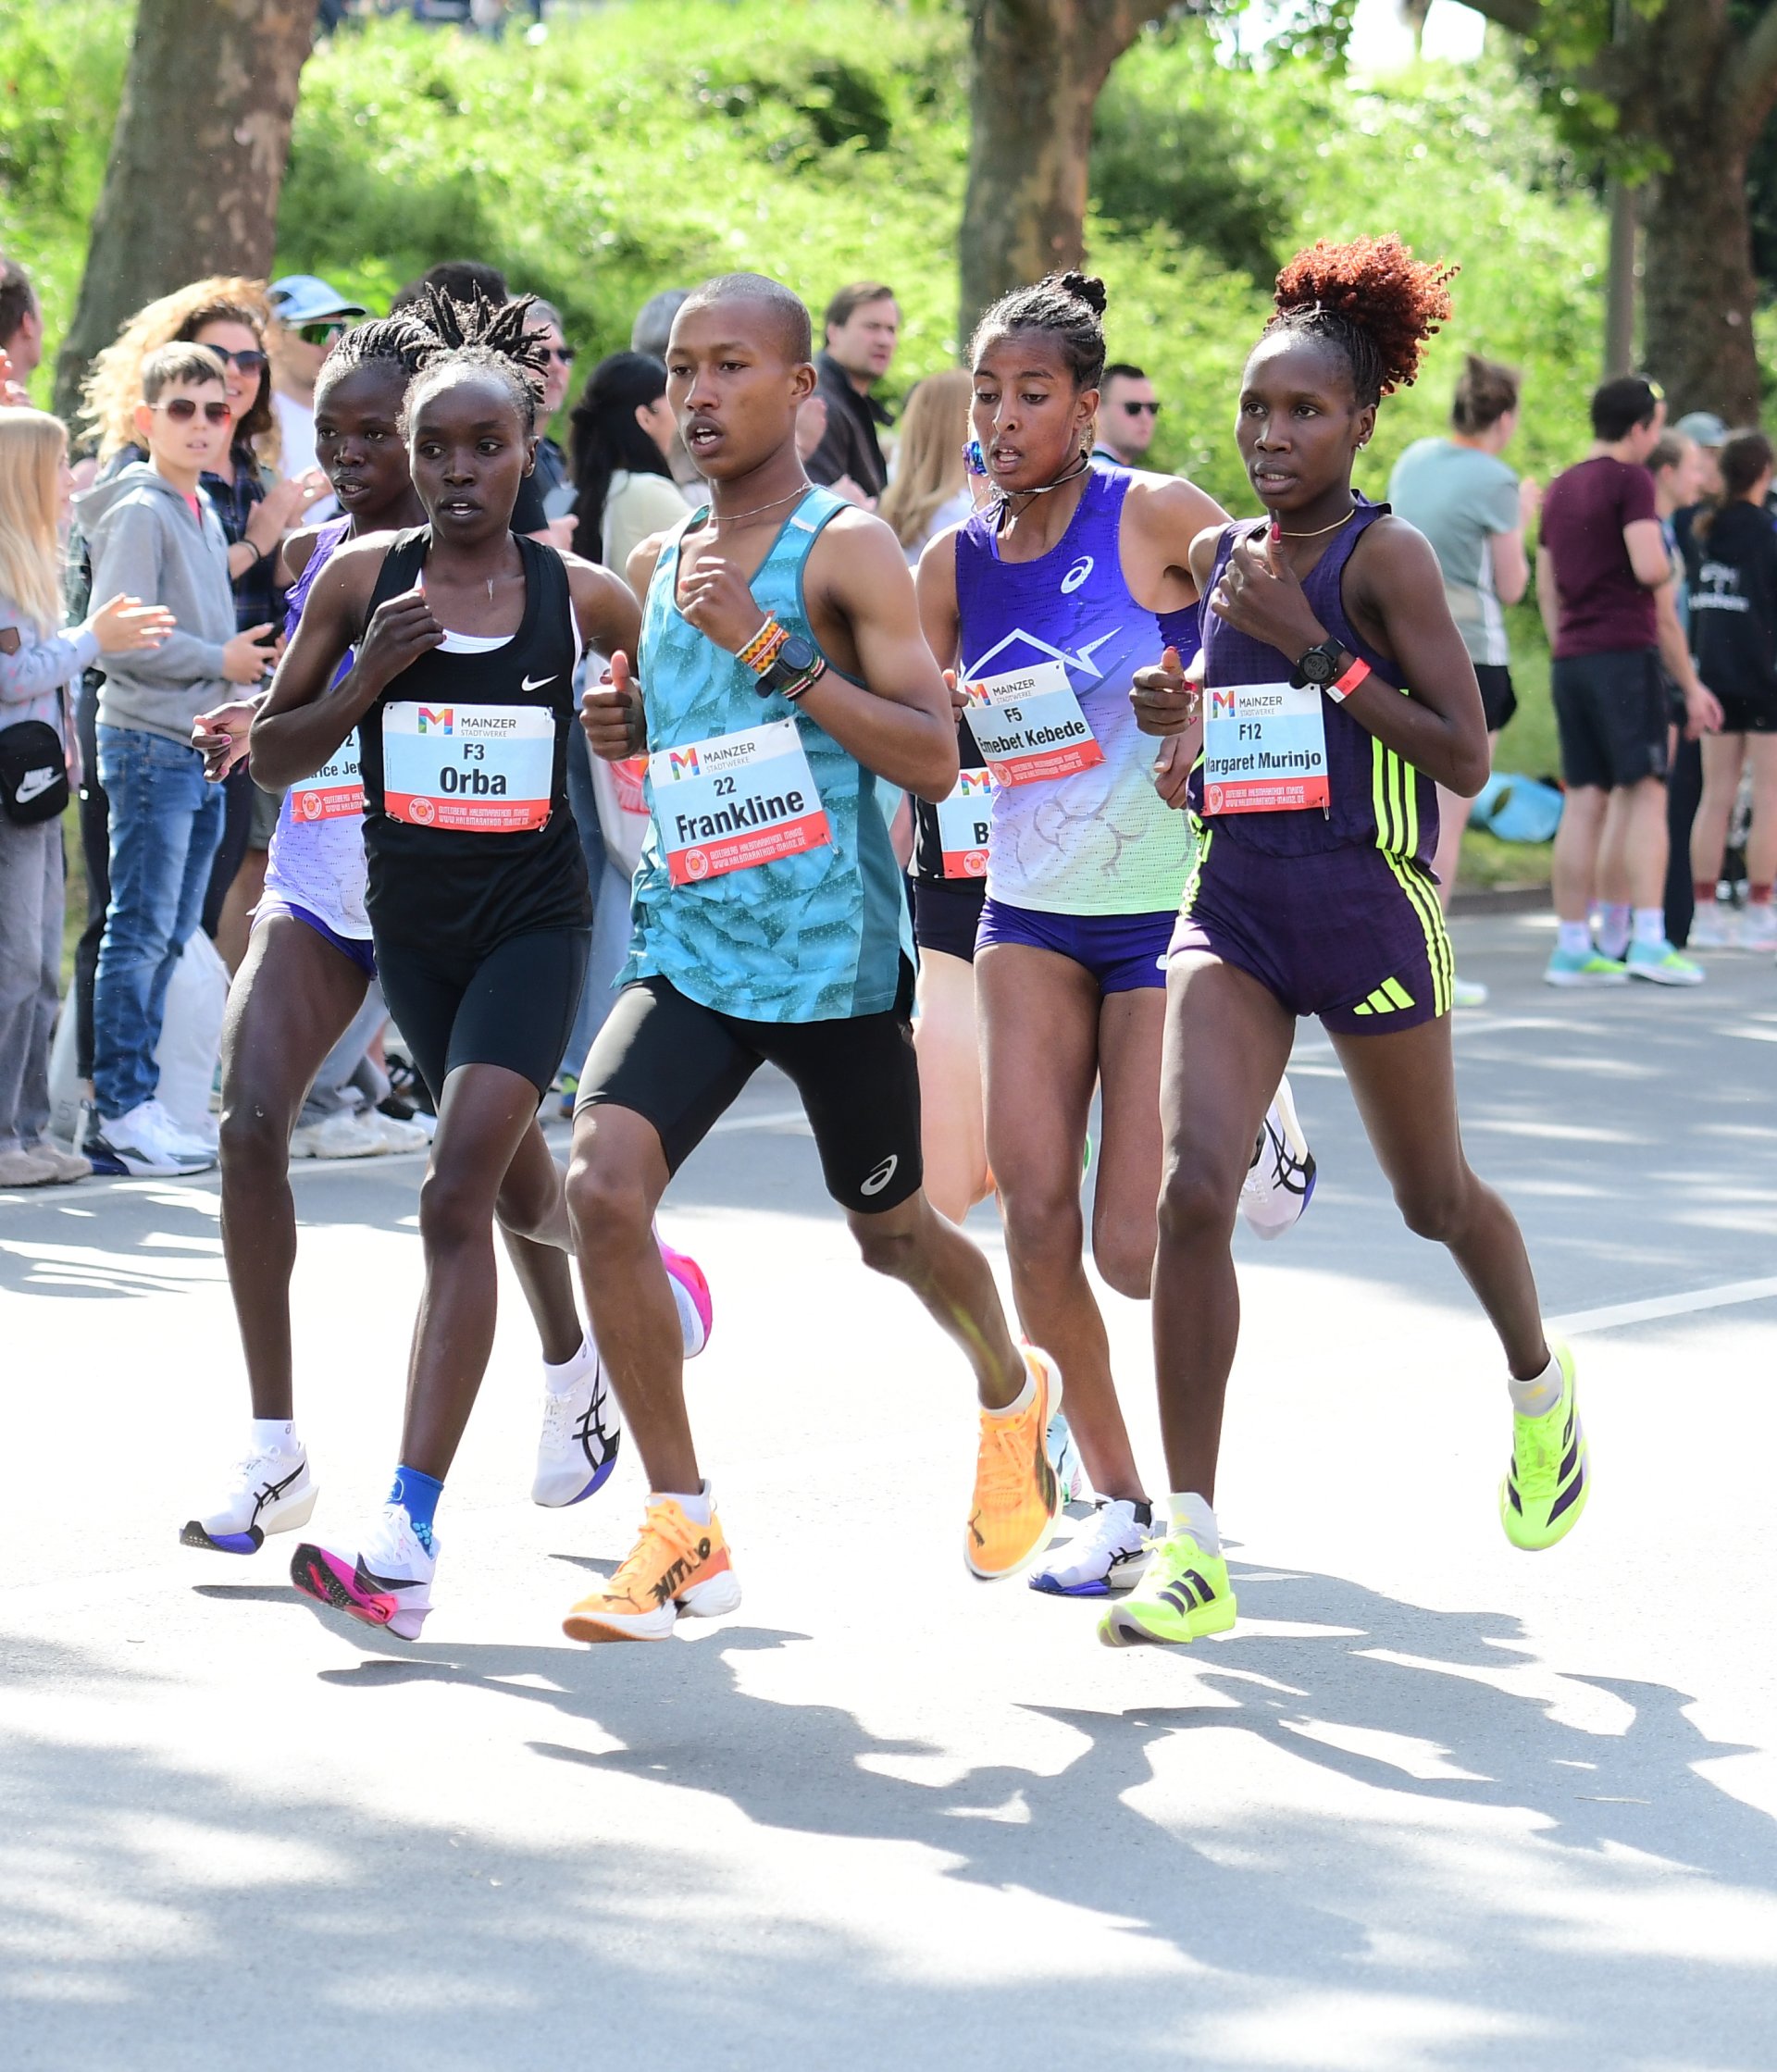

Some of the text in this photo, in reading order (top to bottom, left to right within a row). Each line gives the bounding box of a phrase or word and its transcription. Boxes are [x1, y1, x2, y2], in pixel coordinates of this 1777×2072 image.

[992, 678, 1036, 696] MAINZER
[1239, 696, 1283, 707] MAINZER
[1004, 707, 1023, 723] F5
[1240, 708, 1274, 717] STADTWERKE
[461, 717, 516, 729] MAINZER
[1239, 723, 1261, 740] F12
[461, 729, 507, 738] STADTWERKE
[1025, 721, 1086, 747] Kebede
[463, 743, 484, 761] F3
[703, 742, 756, 764] MAINZER
[1258, 750, 1322, 770] Murinjo
[706, 756, 751, 774] STADTWERKE
[440, 766, 507, 796] Orba
[714, 776, 737, 797] 22
[675, 790, 804, 843] Frankline
[973, 821, 992, 845] B
